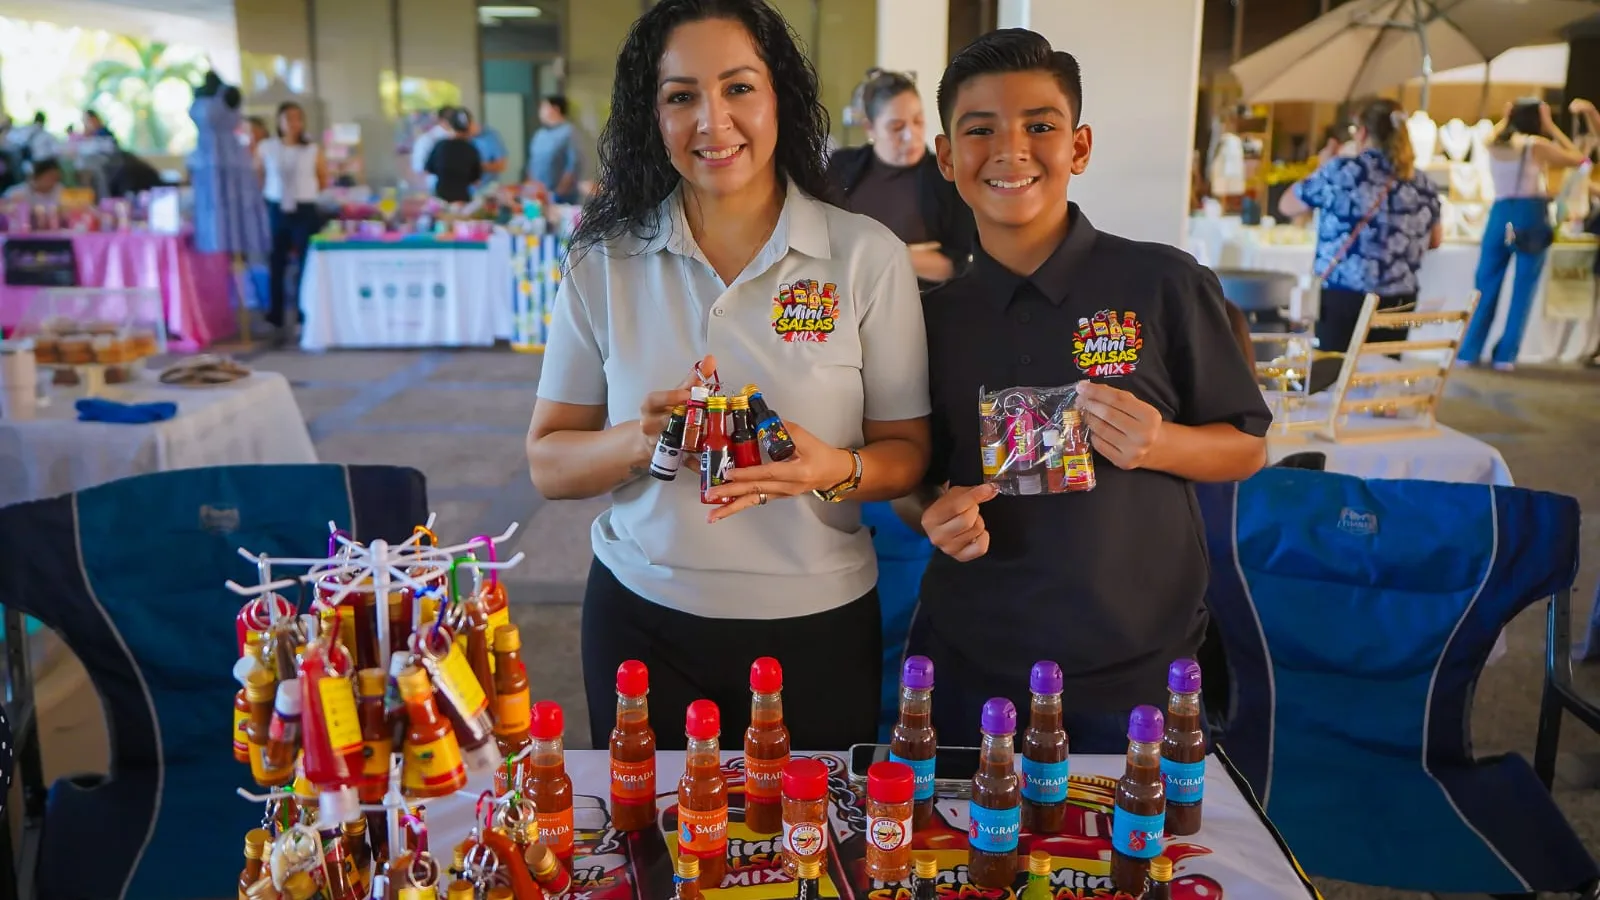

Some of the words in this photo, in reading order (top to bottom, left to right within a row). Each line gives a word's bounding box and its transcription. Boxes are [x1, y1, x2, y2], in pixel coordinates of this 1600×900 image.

[783, 304, 824, 320] Mini
[777, 318, 833, 331] SALSAS
[791, 331, 819, 342] MIX
[1084, 336, 1126, 352] Mini
[1079, 349, 1137, 367] SALSAS
[1095, 362, 1124, 375] MIX
[612, 770, 654, 782] SAGRADA
[728, 836, 783, 858] ini
[720, 869, 790, 888] MIX
[1049, 869, 1114, 889] Min
